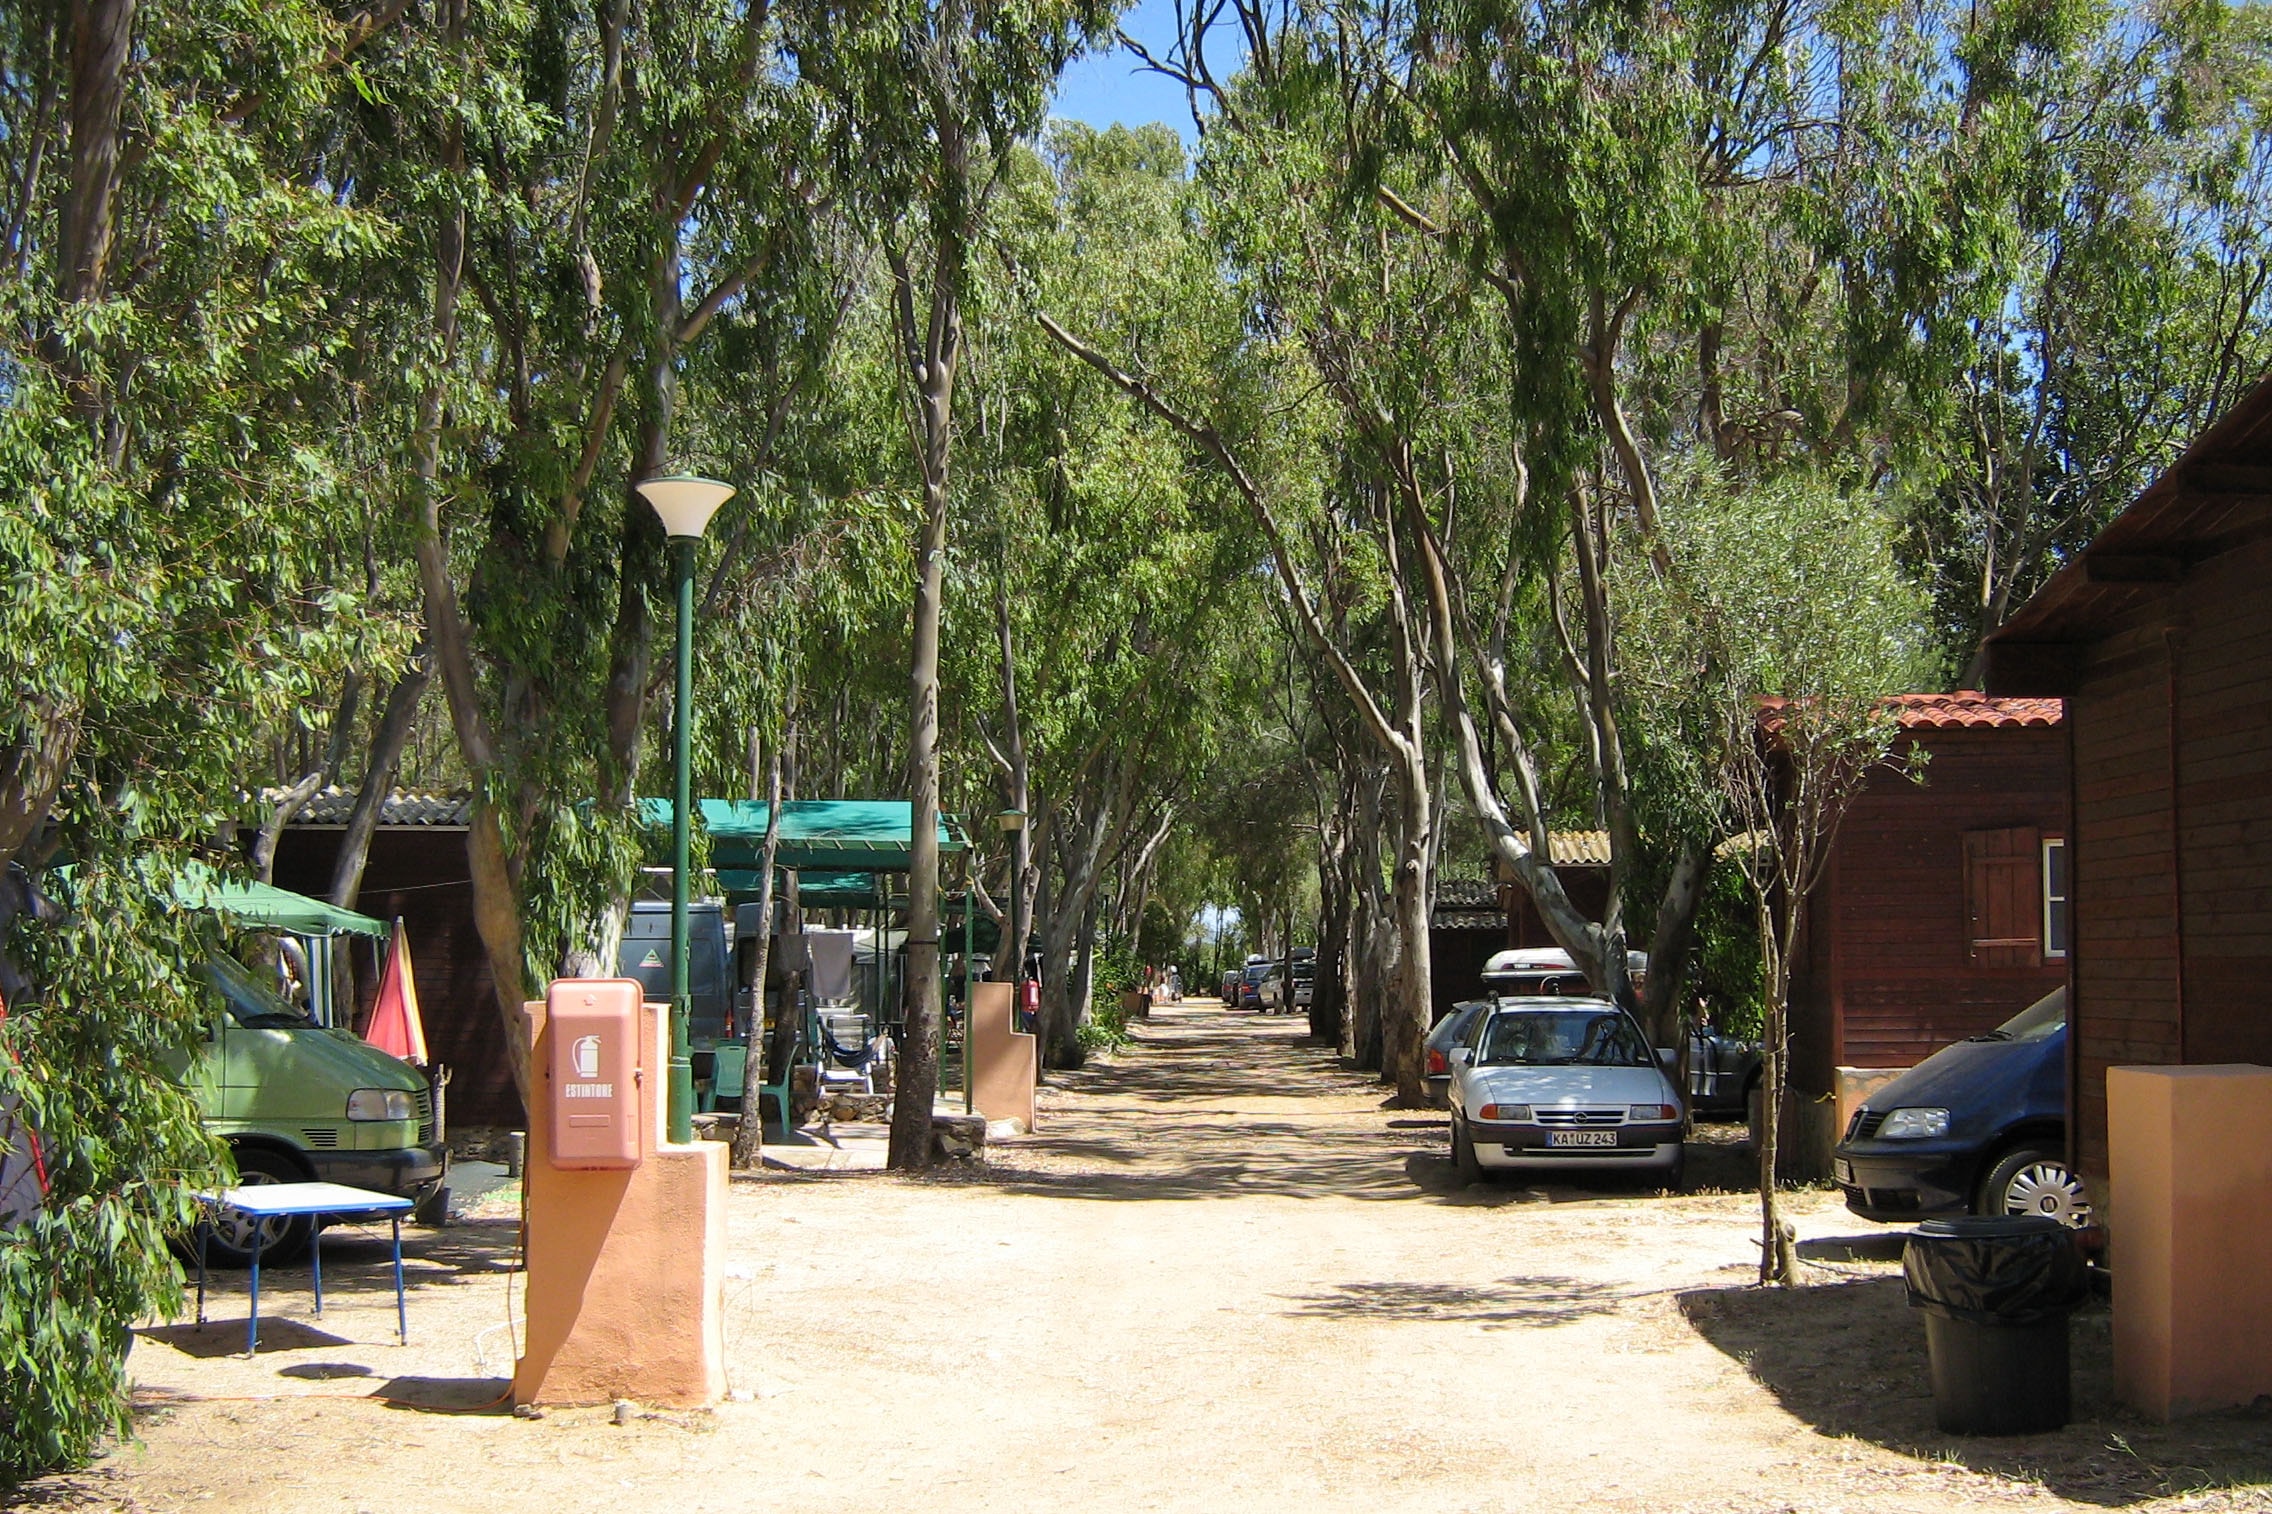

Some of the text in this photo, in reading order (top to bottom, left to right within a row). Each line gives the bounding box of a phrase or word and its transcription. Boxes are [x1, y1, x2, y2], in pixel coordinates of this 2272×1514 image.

[565, 1083, 613, 1098] ESTINTORE
[1553, 1133, 1616, 1145] KA UZ 243
